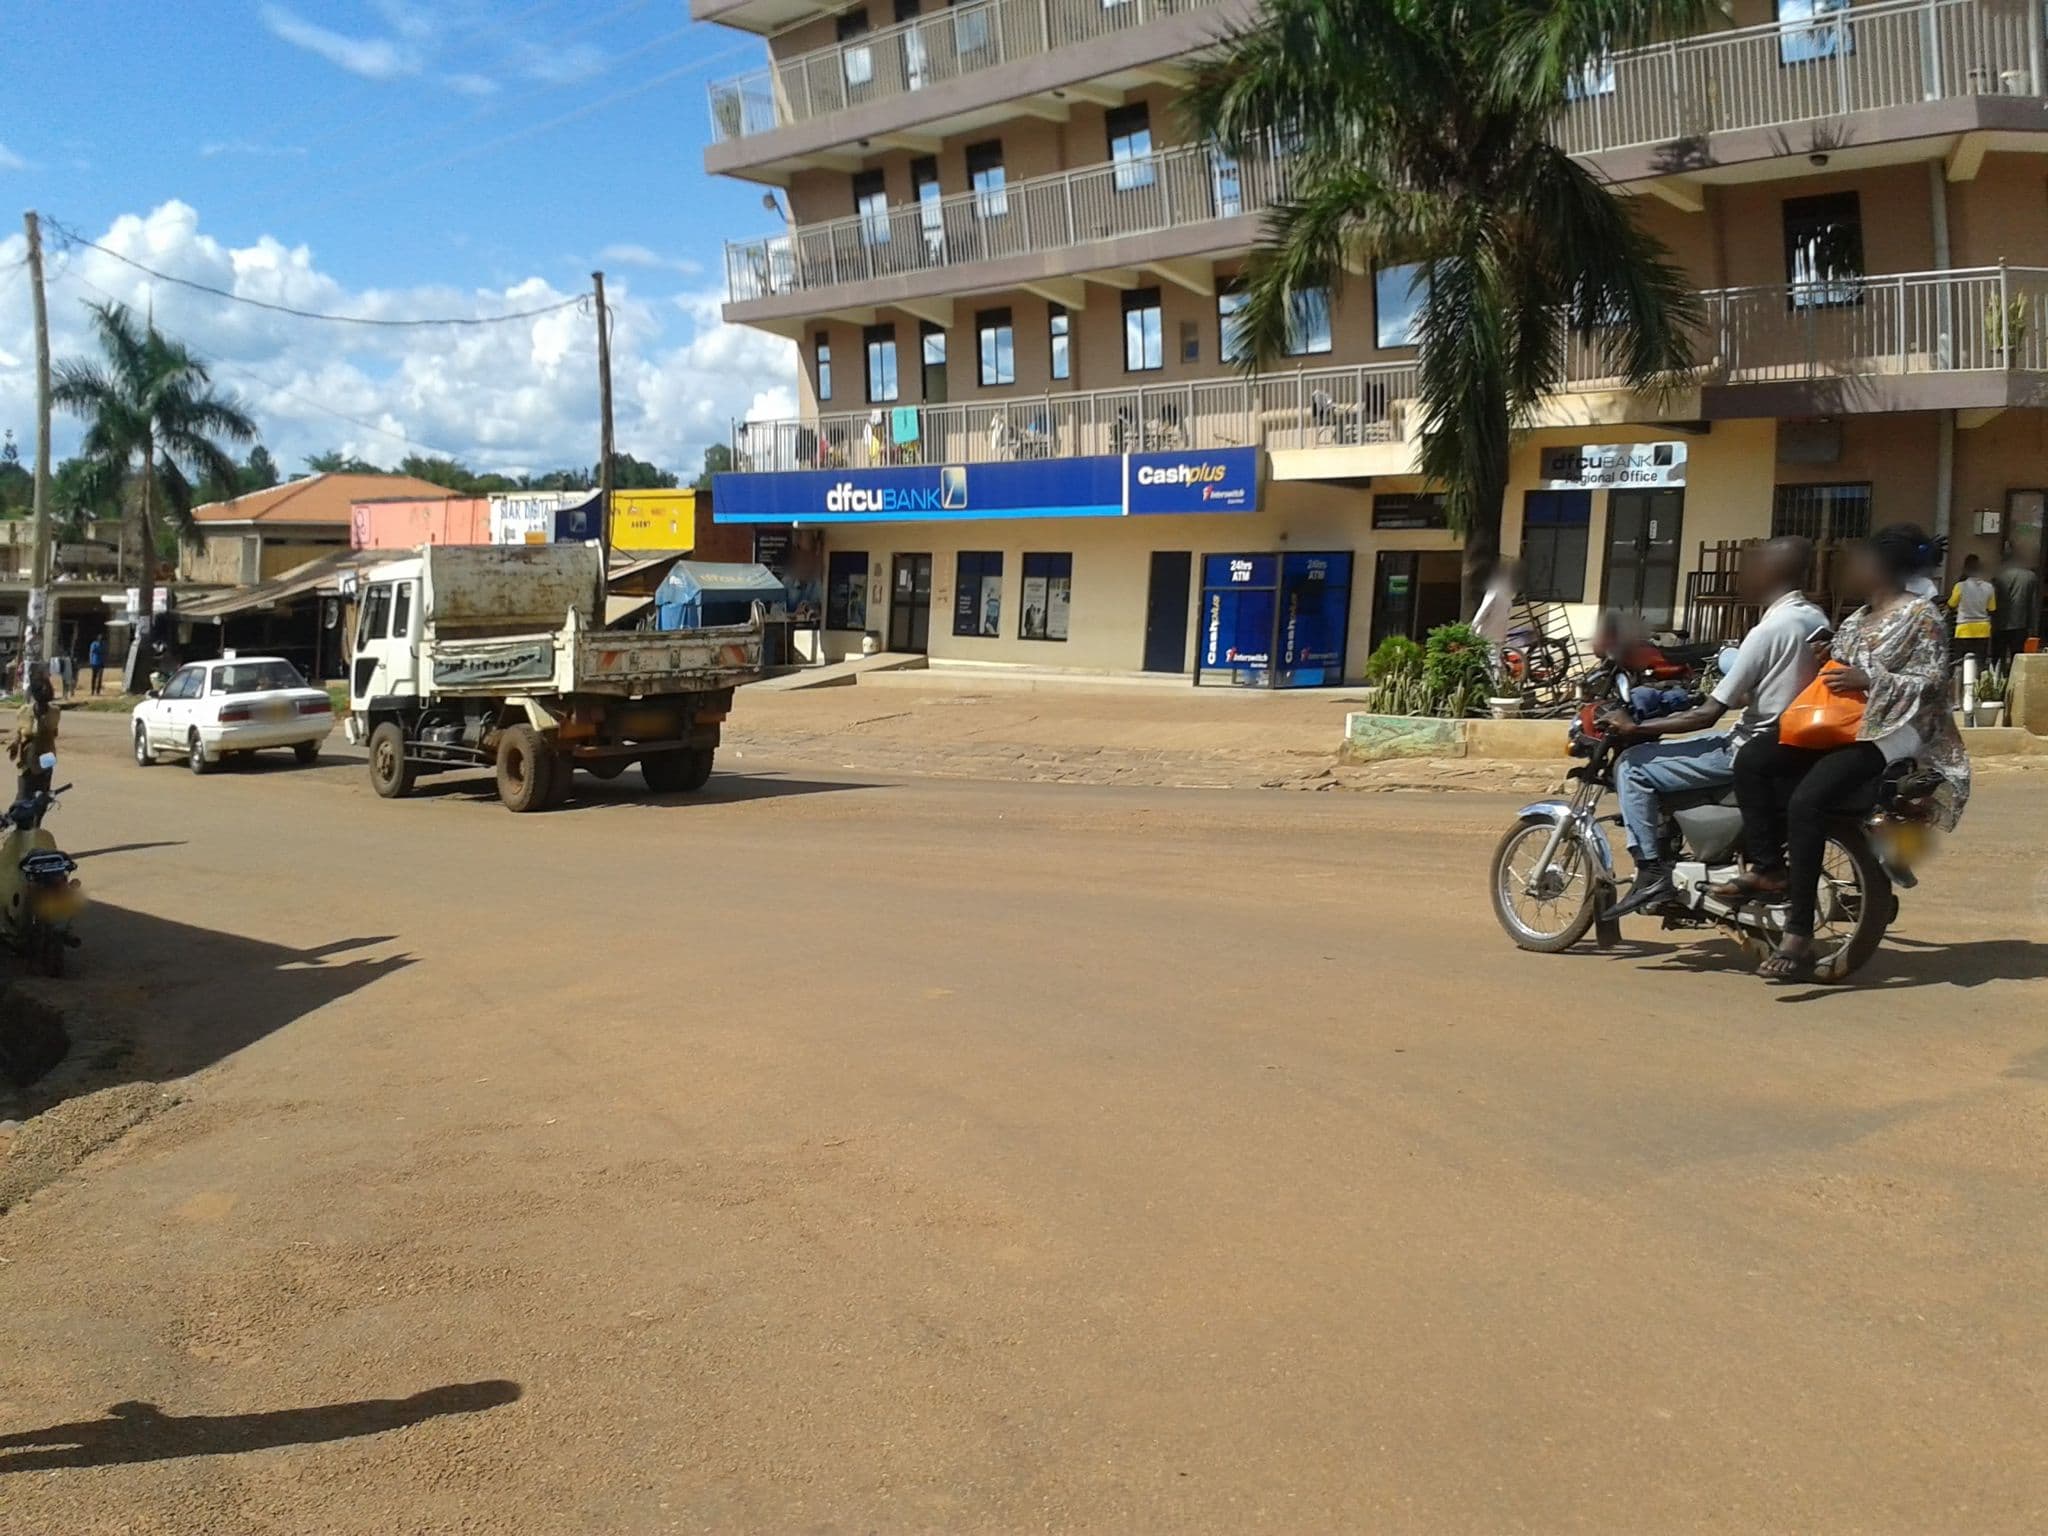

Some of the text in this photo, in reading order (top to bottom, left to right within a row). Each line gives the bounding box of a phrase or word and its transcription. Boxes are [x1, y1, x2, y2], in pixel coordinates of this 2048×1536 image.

[1552, 454, 1652, 470] dfcuBANK
[1138, 463, 1226, 487] Cashplus
[1565, 470, 1658, 486] Regional Office
[827, 482, 941, 512] dfcuBANK
[1230, 560, 1252, 571] 24hrs
[1232, 571, 1250, 582] ATM
